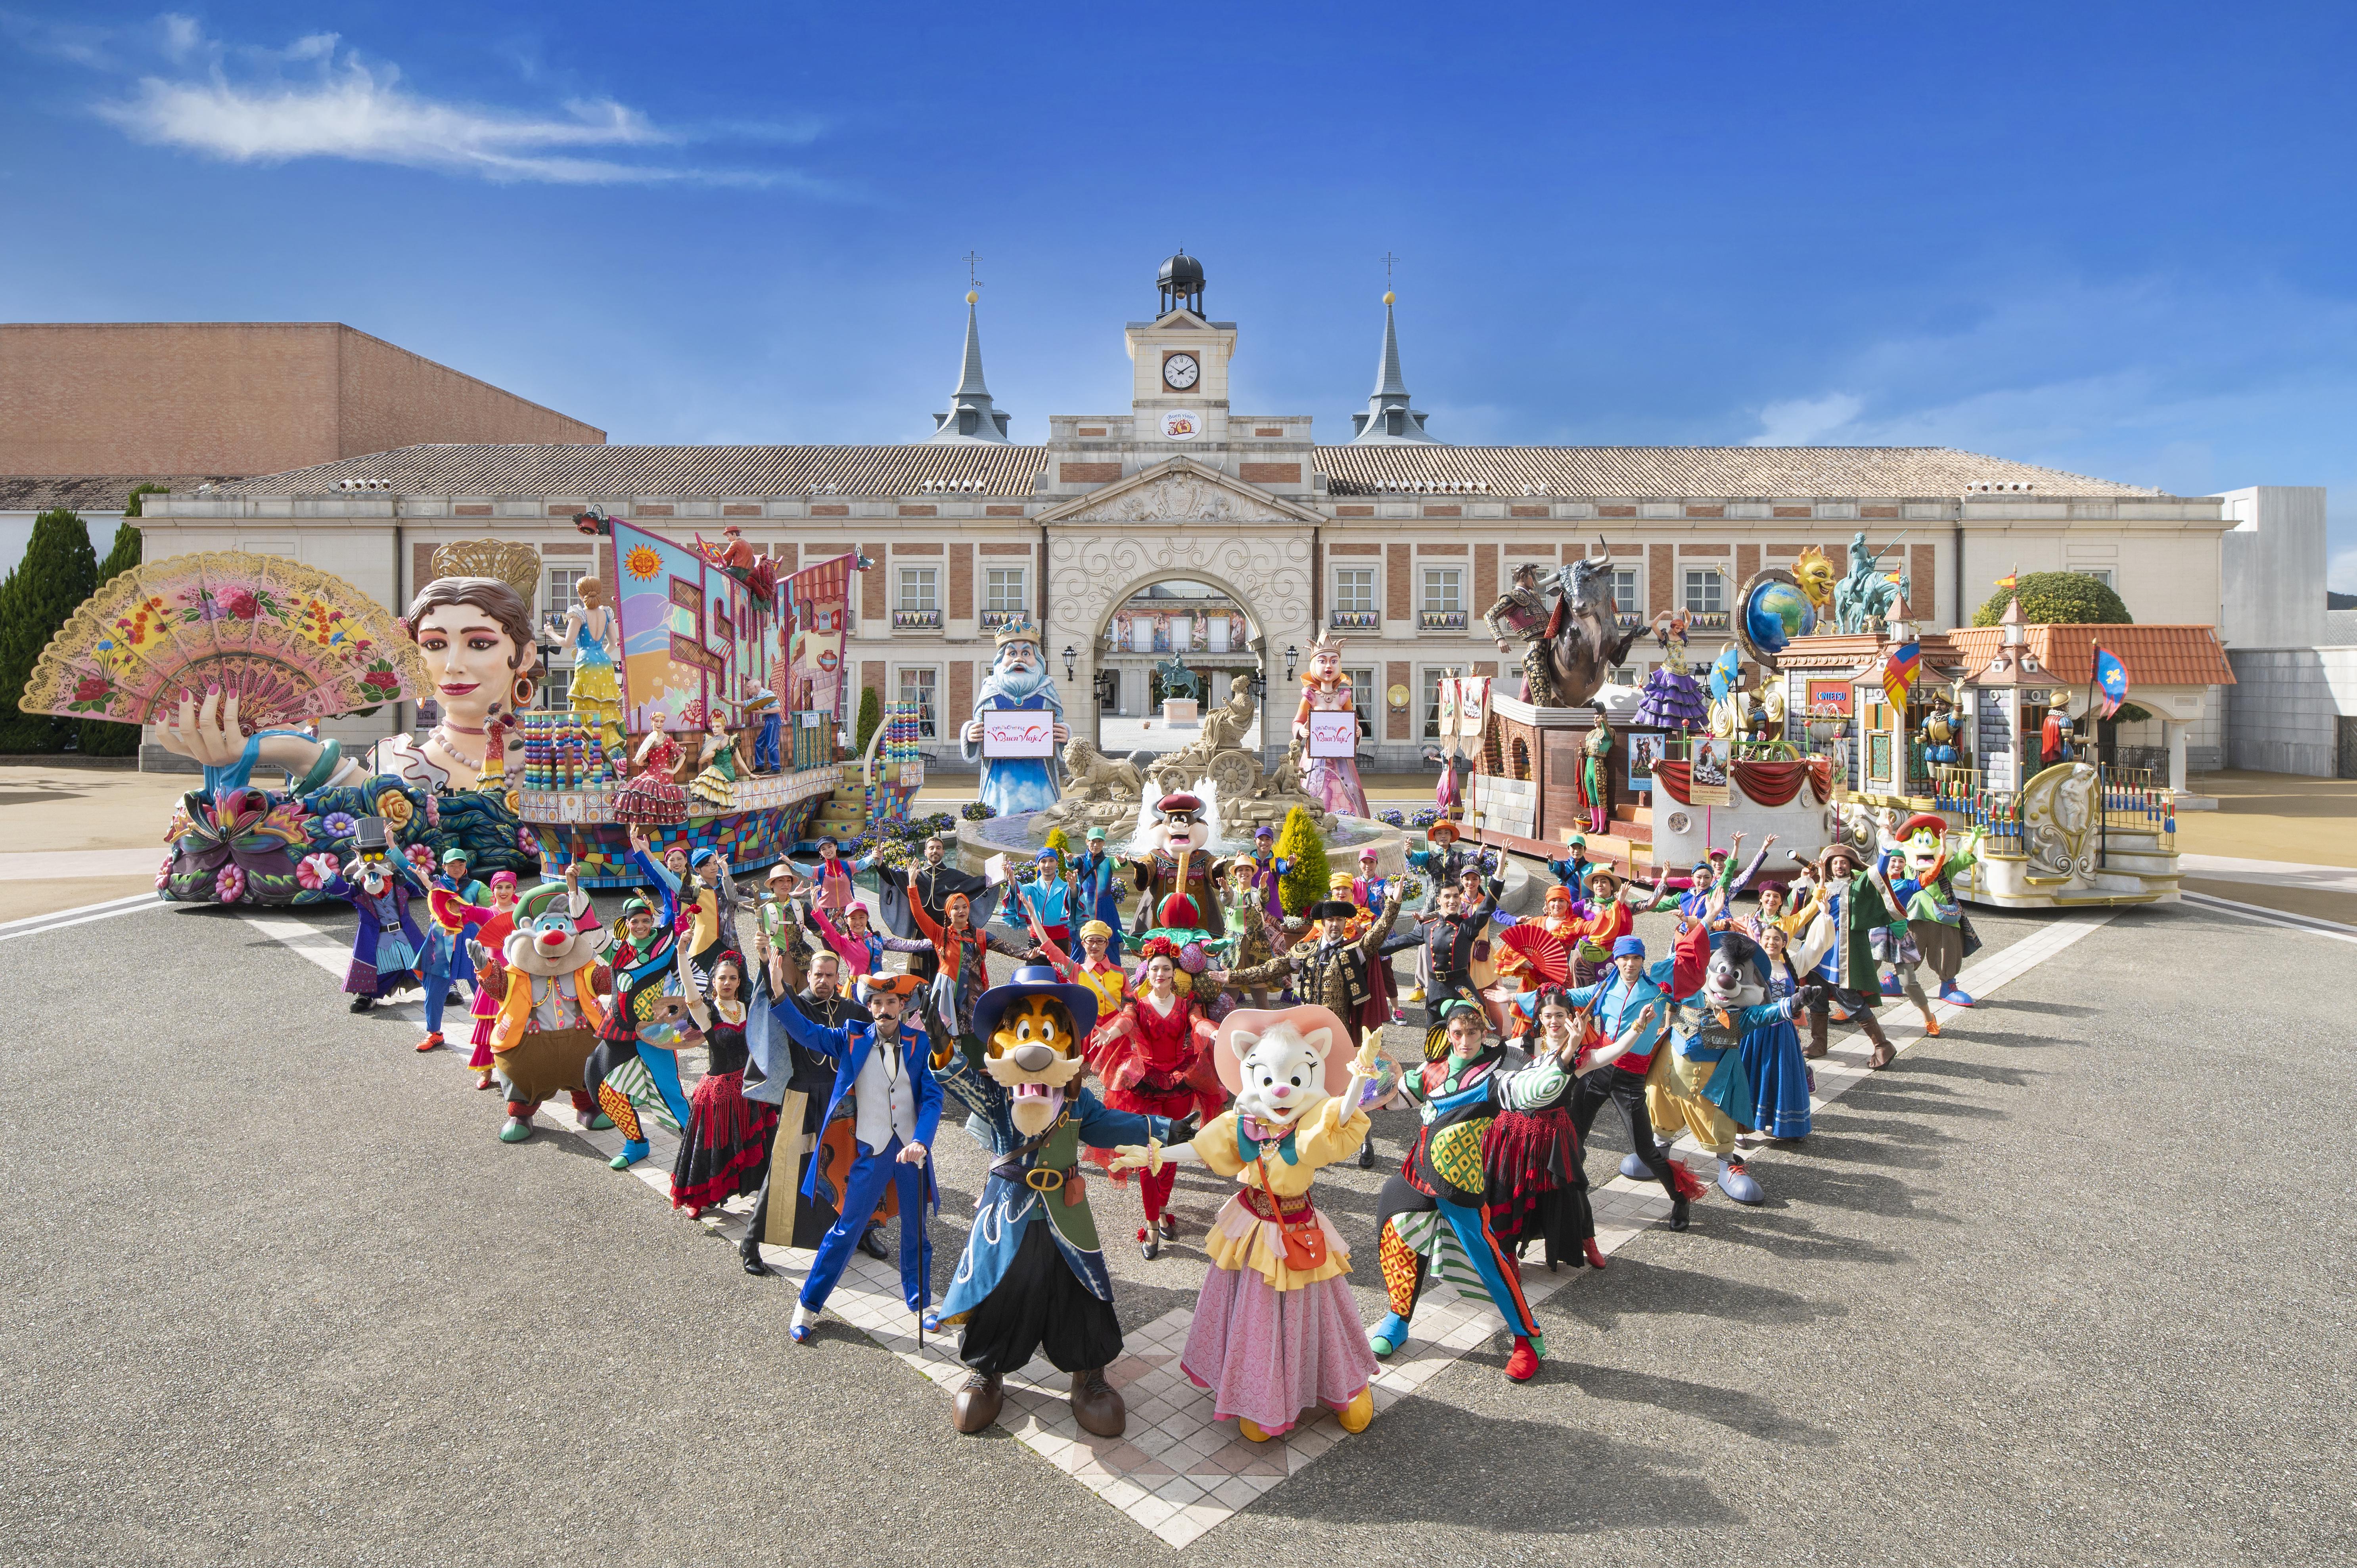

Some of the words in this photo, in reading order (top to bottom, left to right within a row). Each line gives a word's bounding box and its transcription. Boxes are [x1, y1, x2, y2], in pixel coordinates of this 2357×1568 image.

[1817, 692, 1846, 701] KINTETSU
[987, 731, 1018, 742] ¡Buen
[1019, 726, 1050, 743] Viaje!
[1312, 731, 1332, 742] ¡Buen
[1333, 726, 1353, 743] Viaje!
